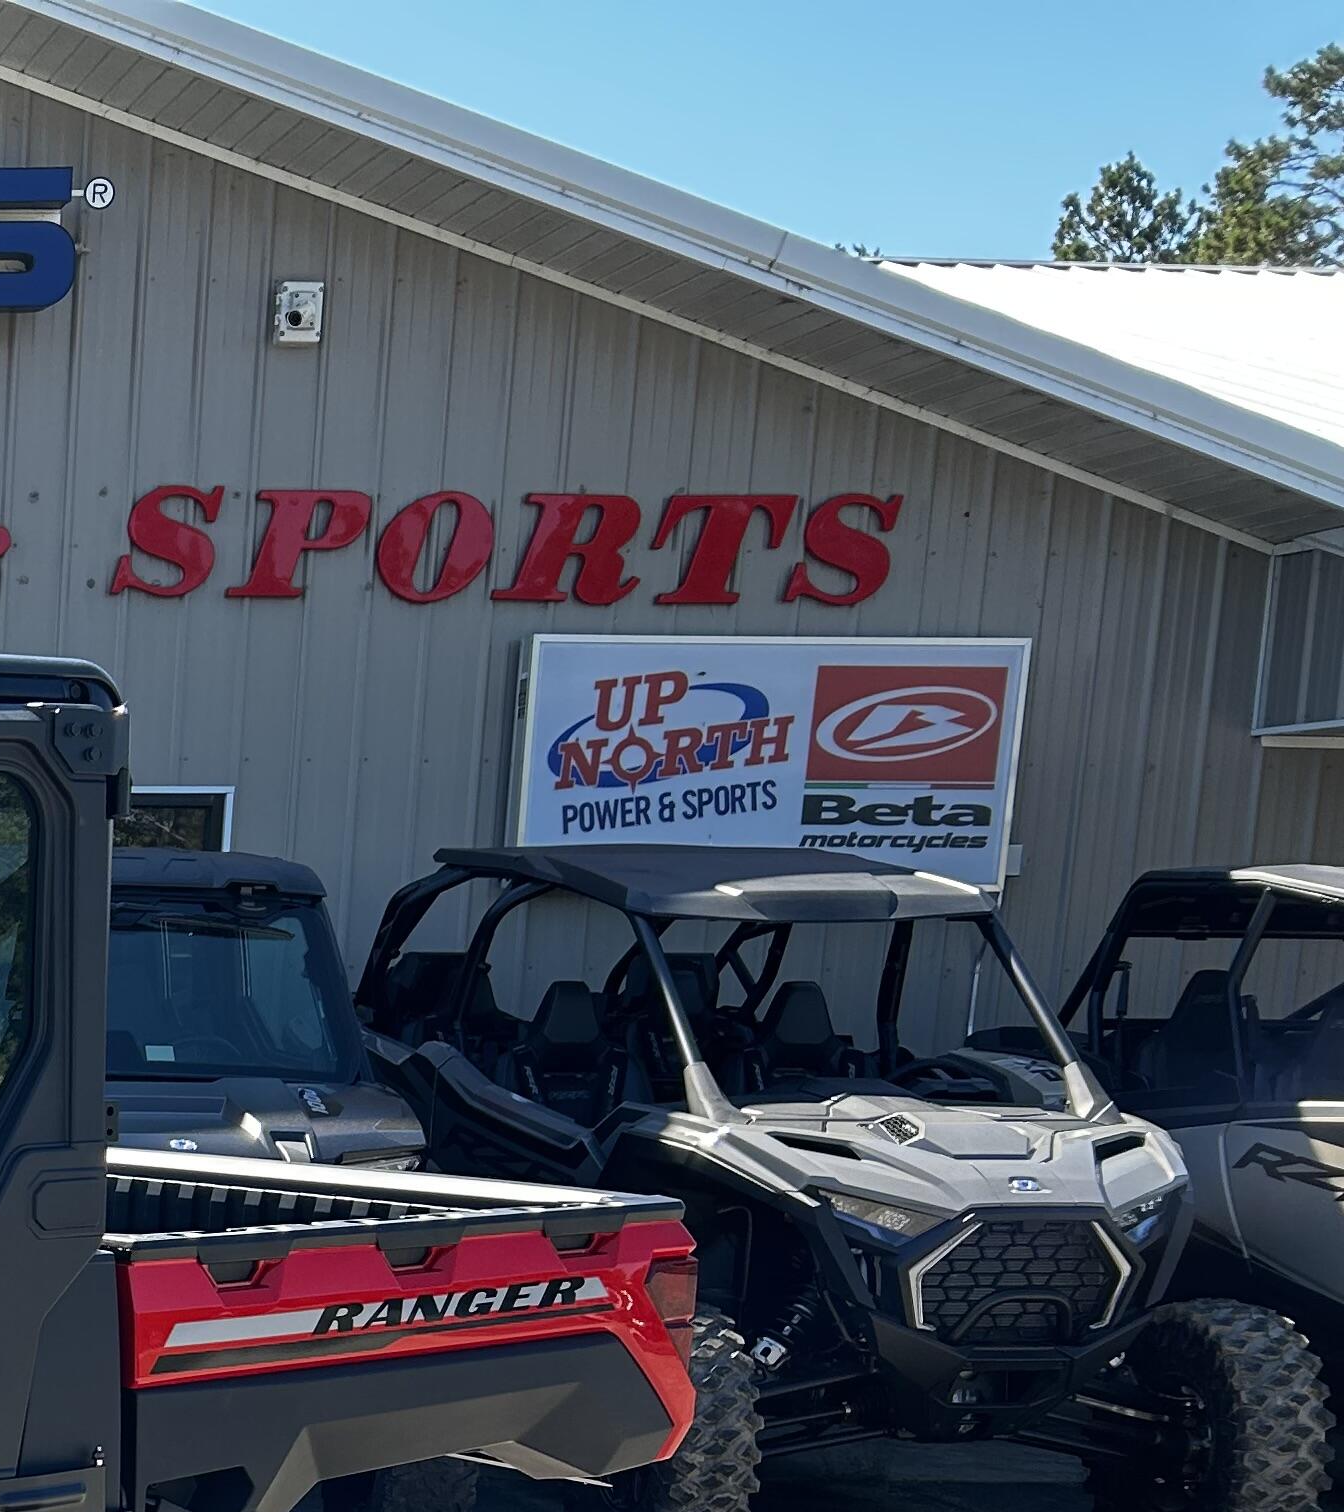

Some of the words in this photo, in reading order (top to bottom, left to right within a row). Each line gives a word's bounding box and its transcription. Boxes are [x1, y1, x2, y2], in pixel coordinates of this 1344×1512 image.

[110, 485, 902, 606] SPORTS
[594, 671, 688, 732] UP
[554, 715, 796, 794] NORTH
[562, 796, 651, 834] POWER
[658, 791, 675, 823] &
[682, 779, 778, 820] SPORTS
[800, 794, 992, 828] Beta
[798, 831, 988, 853] motorcycles
[312, 1276, 586, 1335] RANGER
